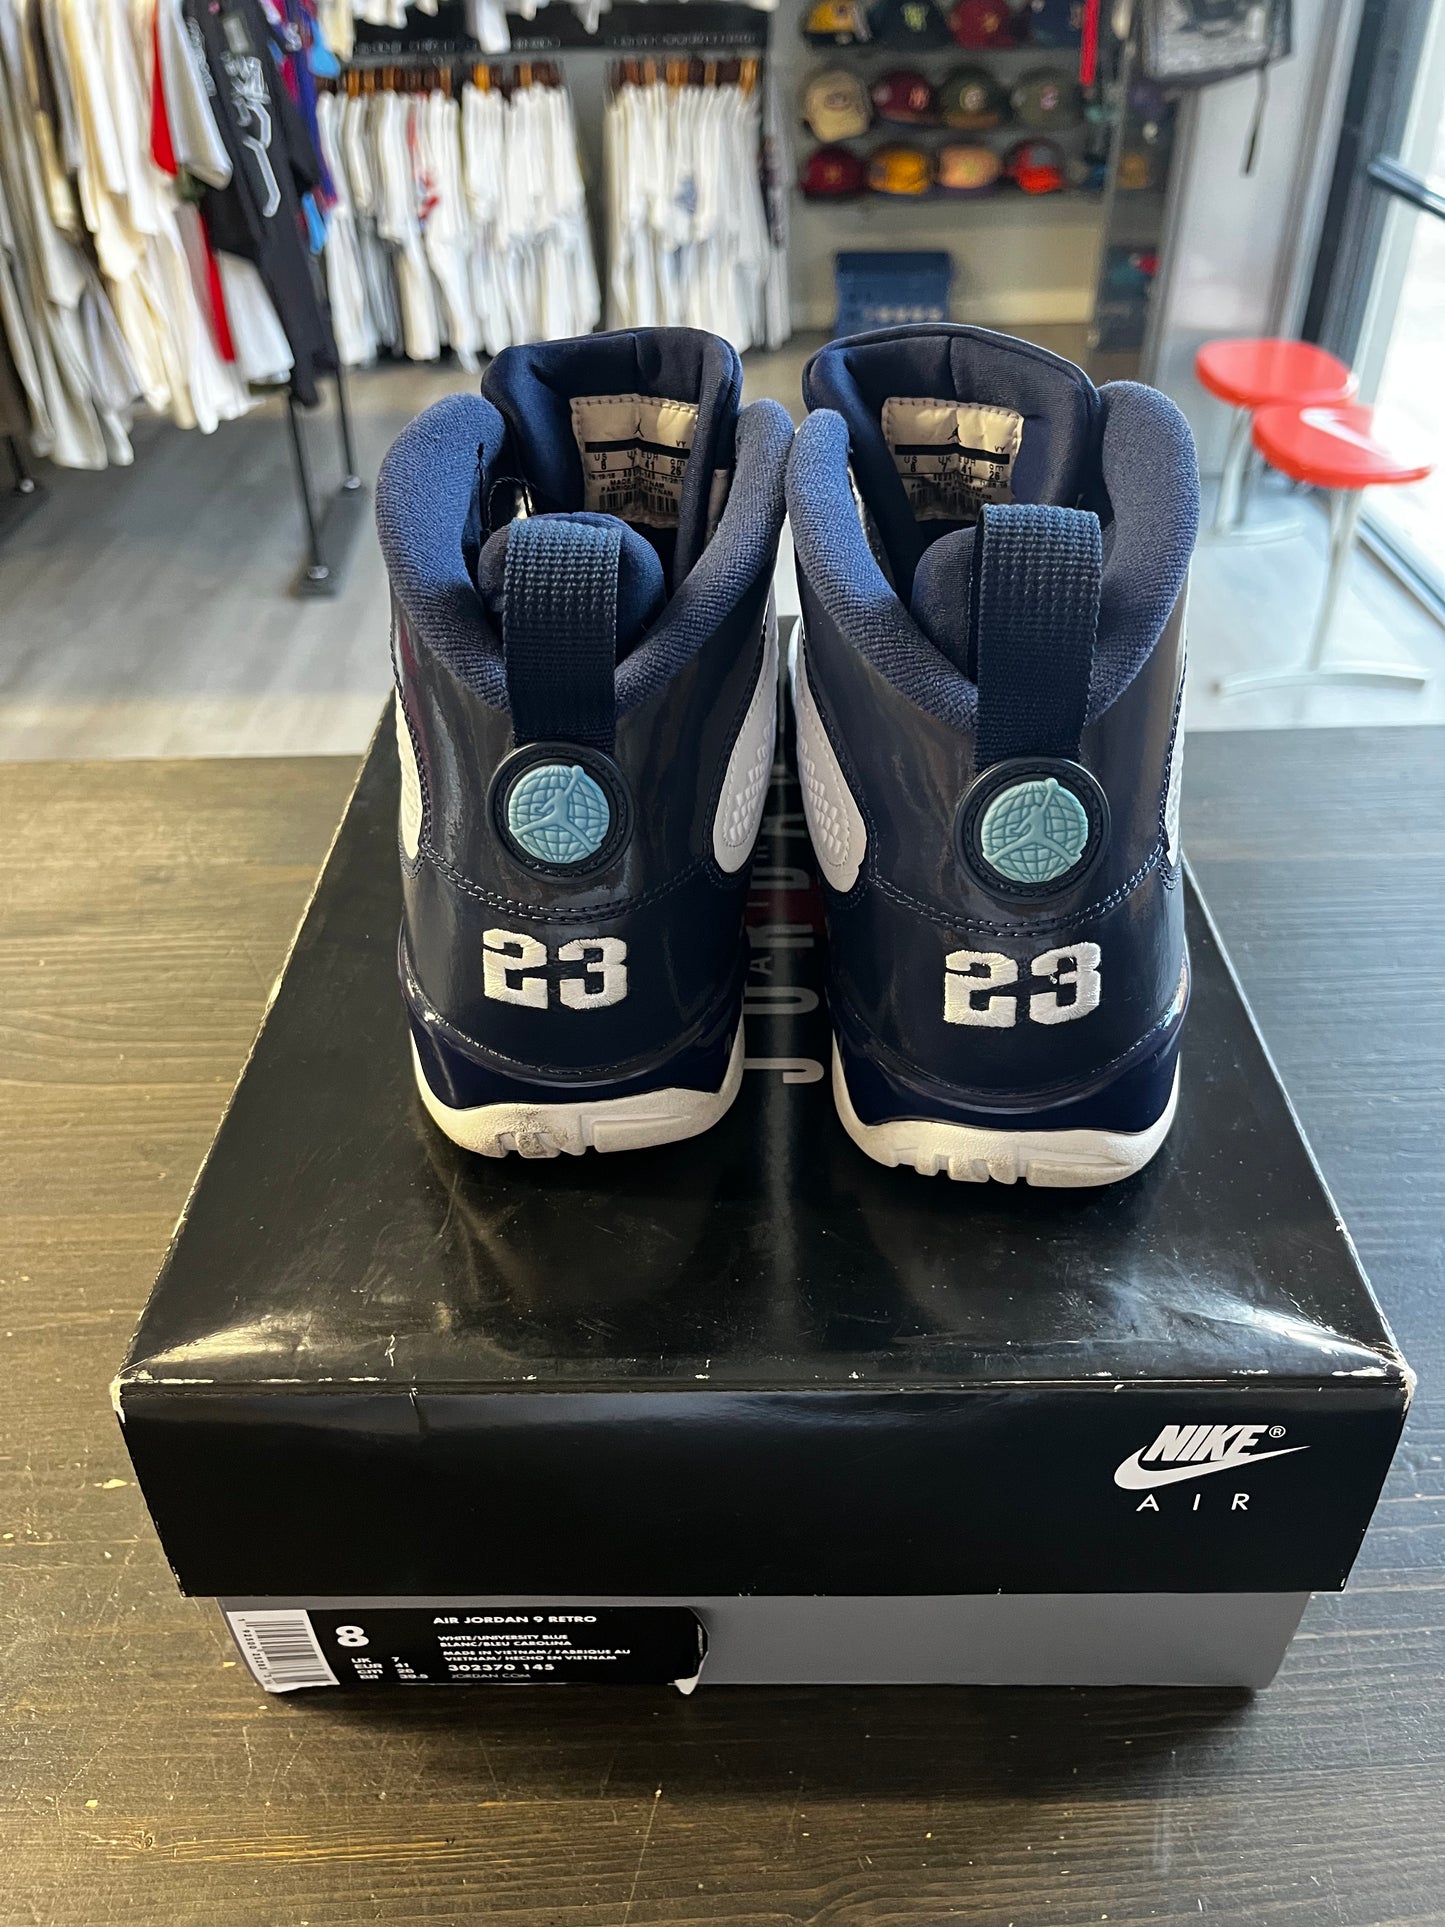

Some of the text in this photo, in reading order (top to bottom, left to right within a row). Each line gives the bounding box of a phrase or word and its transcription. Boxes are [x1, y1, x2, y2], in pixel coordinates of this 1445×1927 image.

[482, 928, 628, 1010] 23
[943, 941, 1102, 1029] 23
[1141, 1424, 1269, 1462] NIKE
[1136, 1493, 1250, 1512] AIR
[433, 1616, 460, 1624] AIR
[464, 1616, 529, 1624] JORDAN
[335, 1625, 370, 1648] 8
[438, 1634, 540, 1642] WHITE/UNIVERSITY
[448, 1663, 555, 1672] 302370 145
